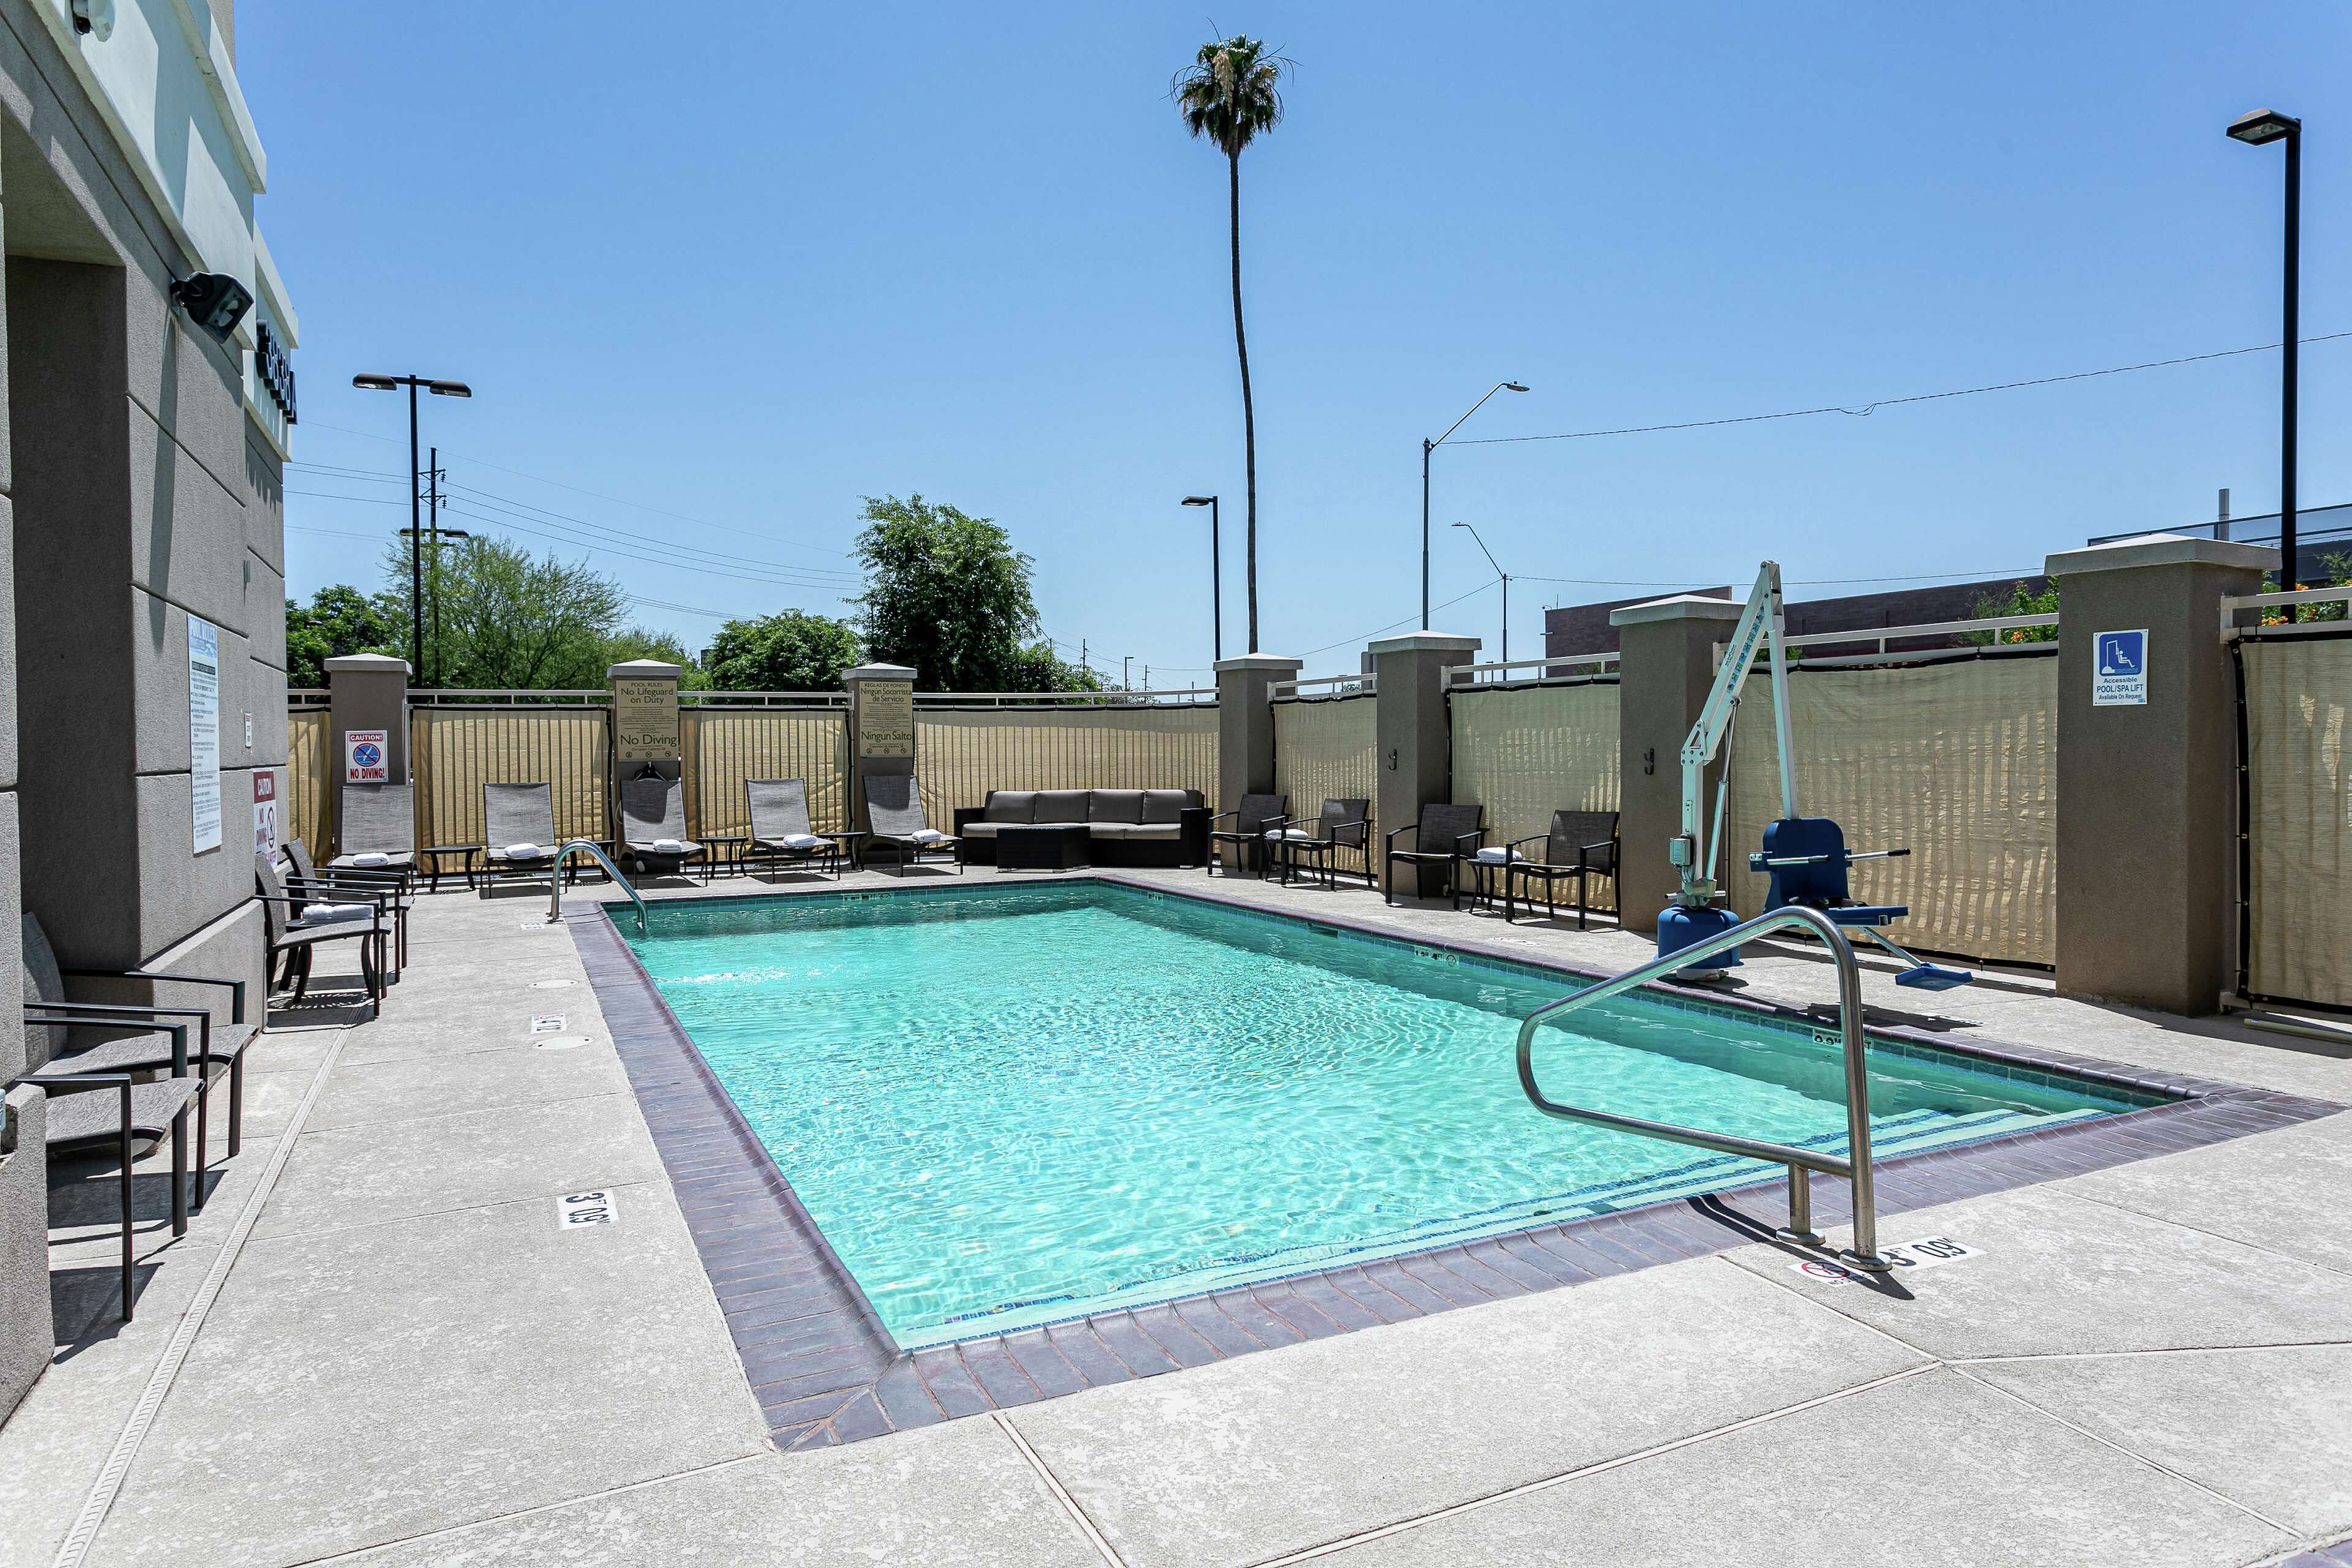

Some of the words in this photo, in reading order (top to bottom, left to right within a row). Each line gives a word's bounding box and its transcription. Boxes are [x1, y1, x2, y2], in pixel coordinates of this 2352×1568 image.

[637, 687, 674, 697] Lifeguard
[644, 696, 665, 705] Duty
[620, 734, 639, 745] No
[642, 734, 677, 747] Diving
[861, 731, 891, 743] Ningún
[892, 731, 912, 741] Salto
[350, 768, 360, 780] NO
[361, 767, 385, 779] DIVING!
